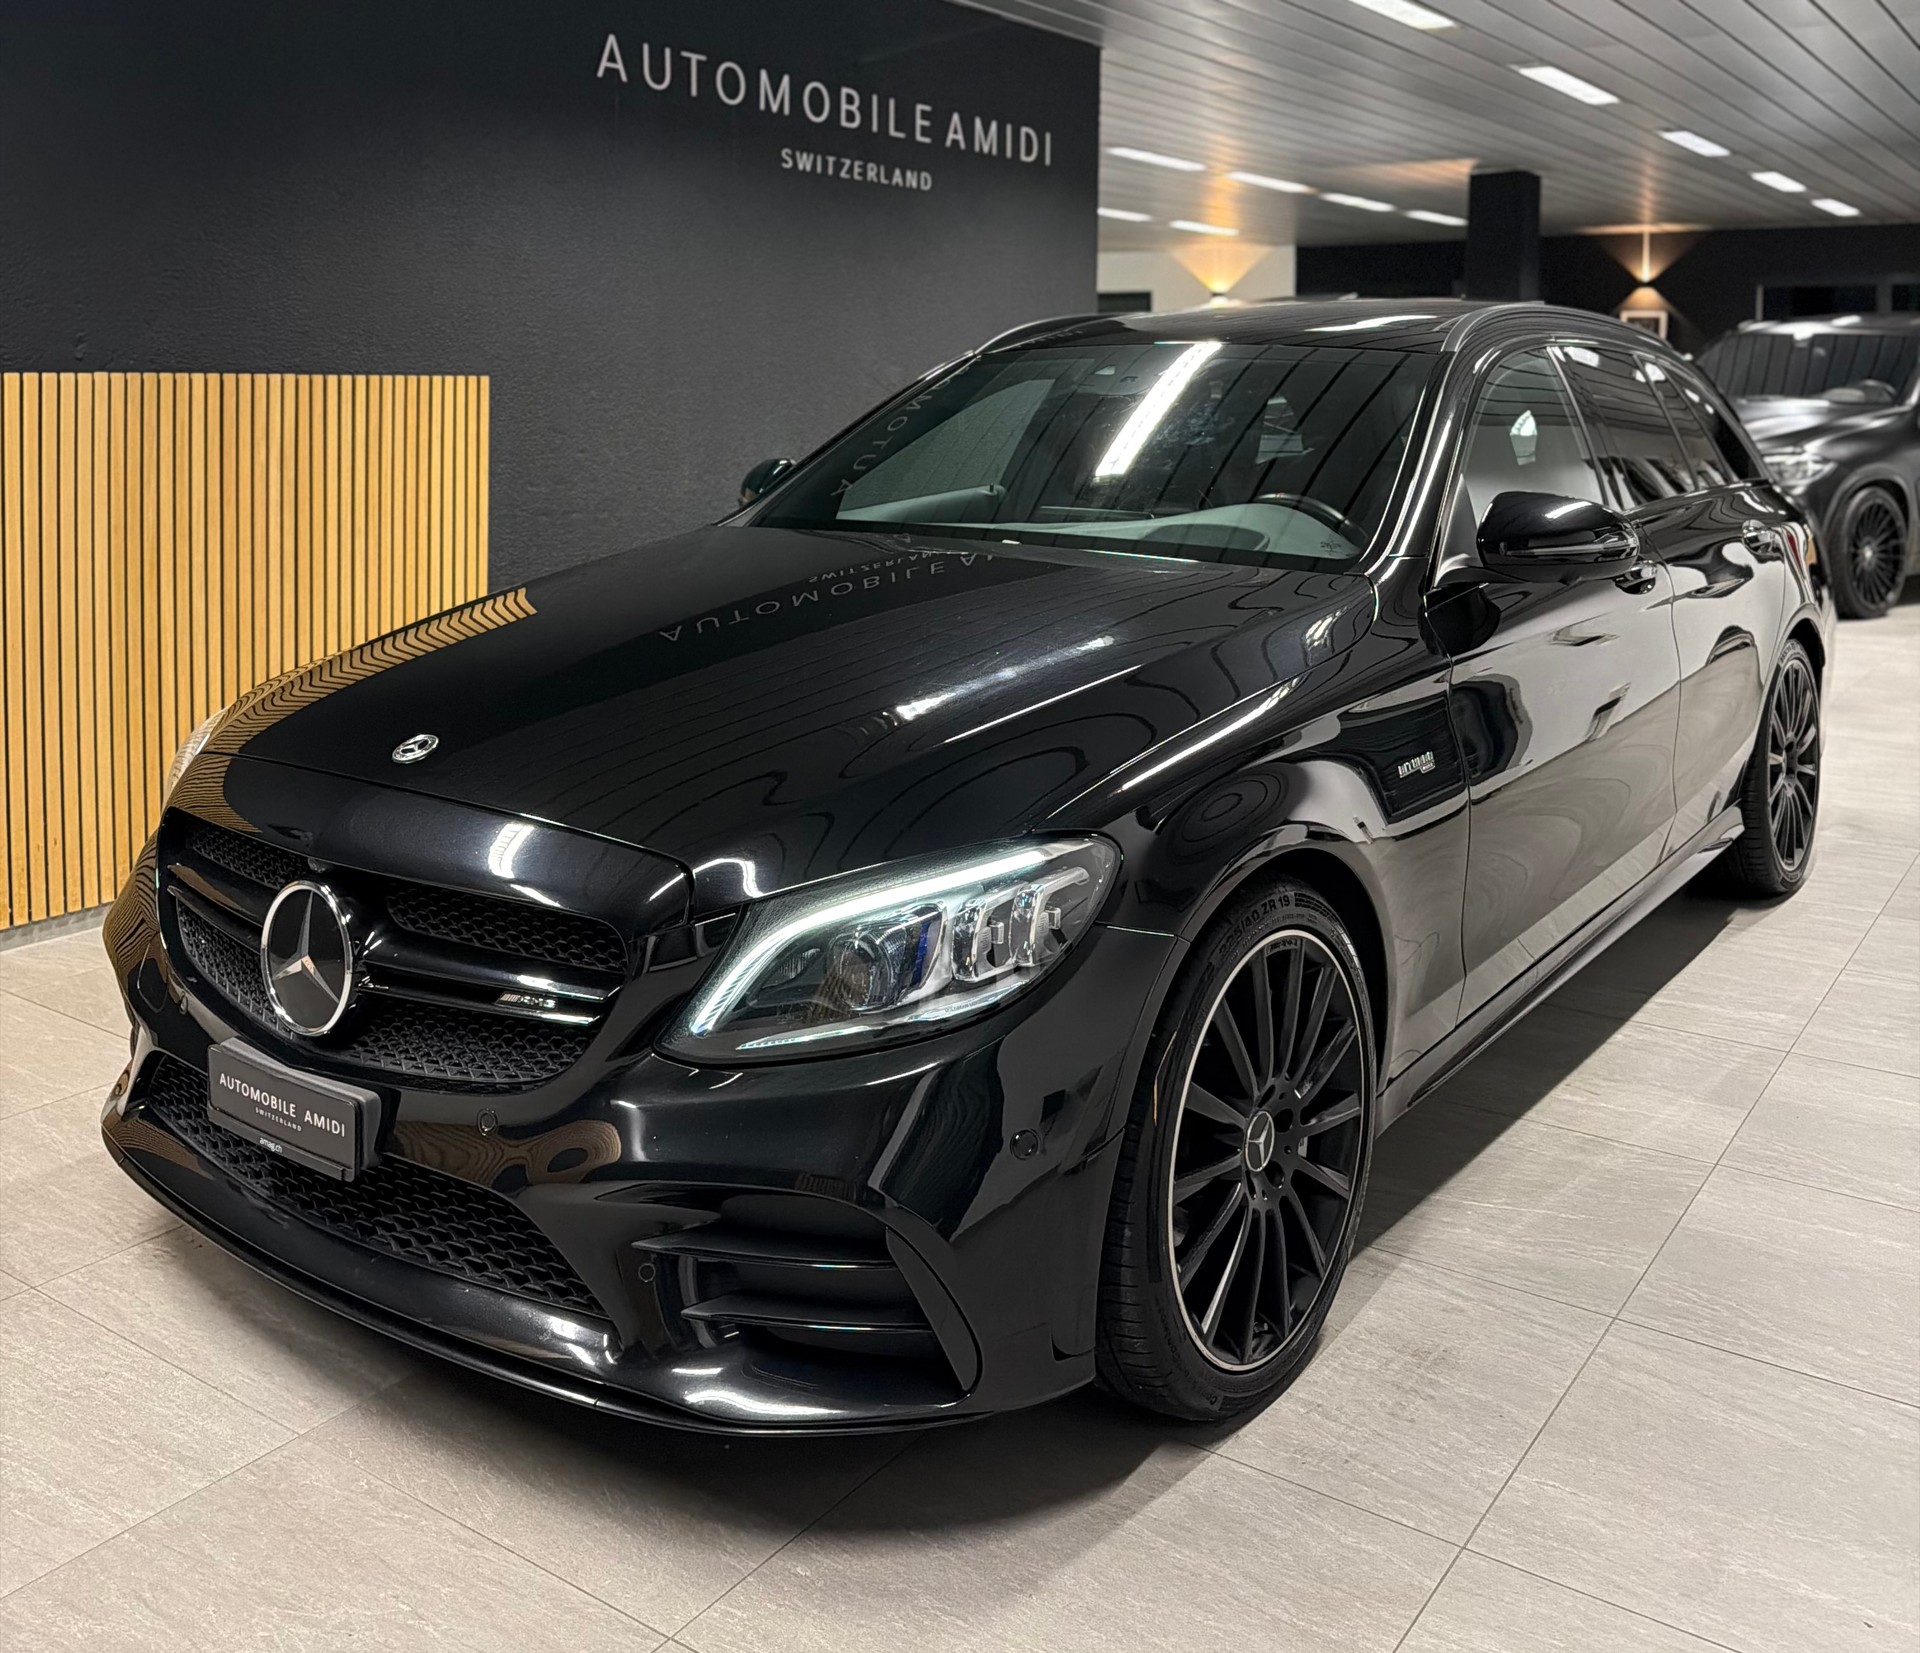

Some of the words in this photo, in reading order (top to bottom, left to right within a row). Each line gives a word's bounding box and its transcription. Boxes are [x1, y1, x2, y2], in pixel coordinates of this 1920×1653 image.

[597, 34, 932, 144] AUTOMOBILE
[945, 111, 1052, 167] AMIDI
[780, 148, 933, 191] SWITZERLAND
[1279, 895, 1290, 907] 19
[219, 1073, 296, 1117] AUTOMOBILE
[304, 1110, 345, 1137] AMIDI
[255, 1107, 302, 1132] SWITZERLAND
[259, 1137, 283, 1154] amag.ch
